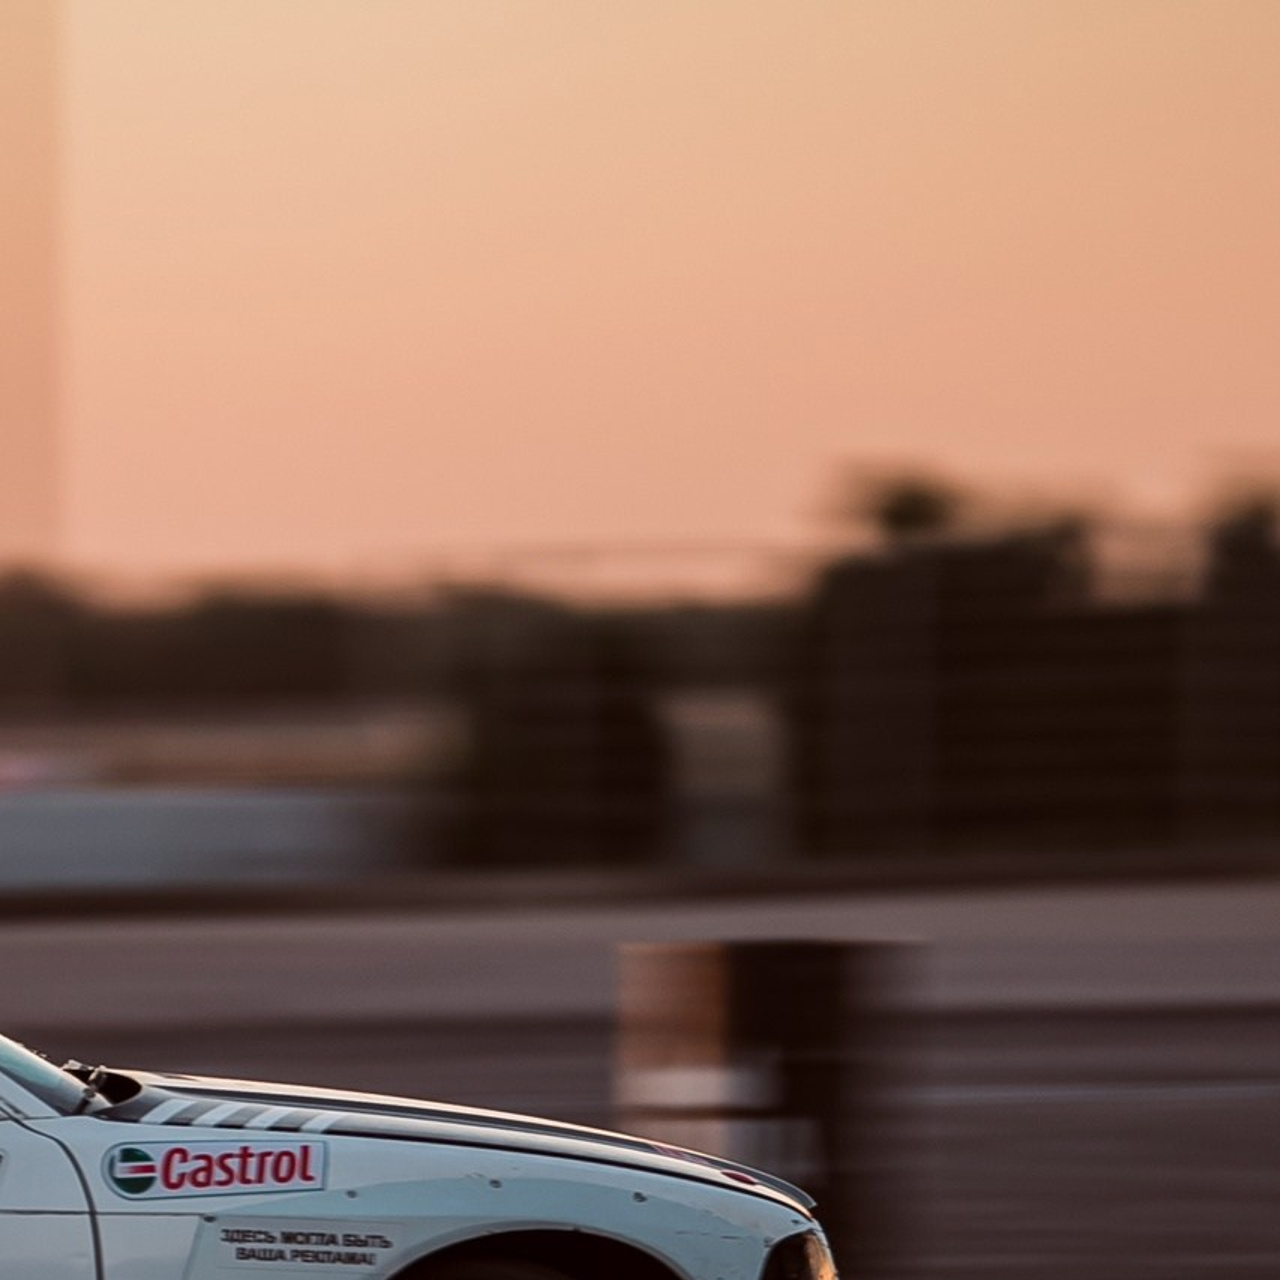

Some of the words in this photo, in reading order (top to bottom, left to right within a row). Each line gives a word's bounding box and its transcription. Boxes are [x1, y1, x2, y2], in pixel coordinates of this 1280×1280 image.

[161, 1145, 316, 1189] Castrol
[221, 1229, 277, 1244] ЗДЕСЬ
[342, 1233, 393, 1249] БЫТЬ
[236, 1246, 287, 1262] ВАША
